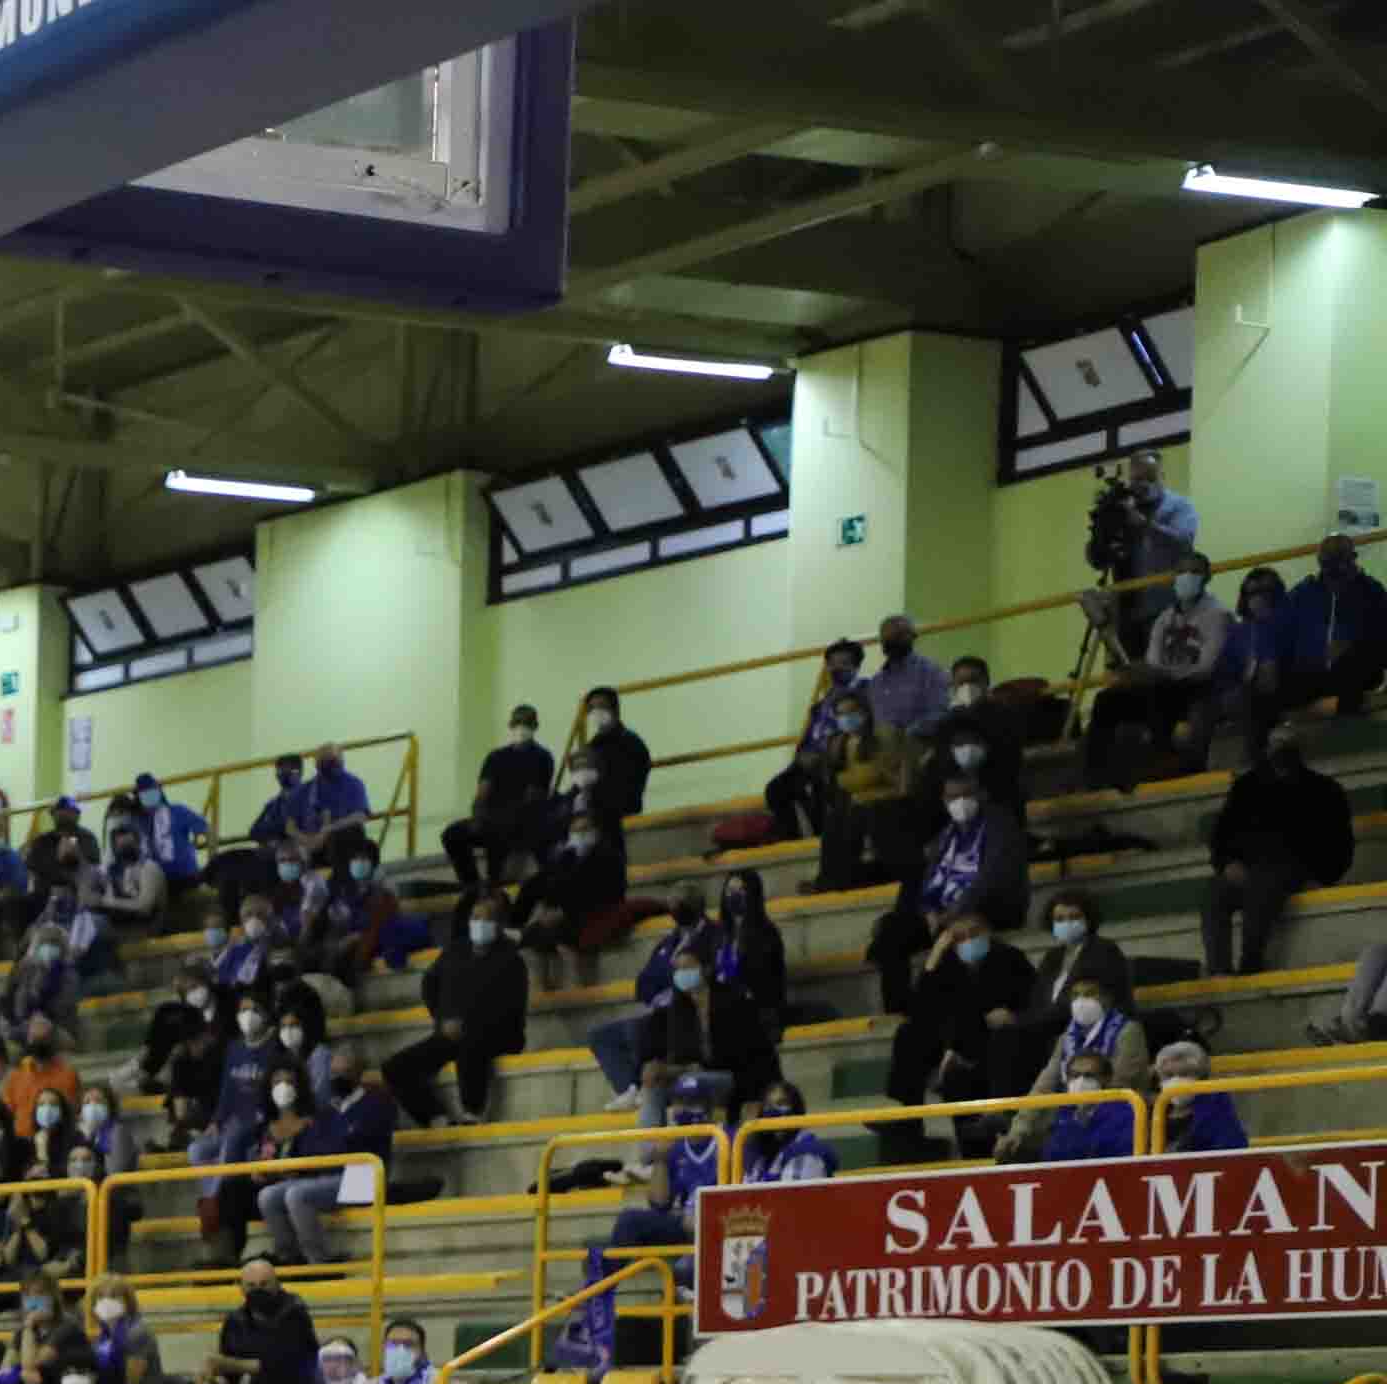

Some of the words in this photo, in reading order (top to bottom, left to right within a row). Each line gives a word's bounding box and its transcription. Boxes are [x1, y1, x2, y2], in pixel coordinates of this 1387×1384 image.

[884, 1160, 1386, 1256] SALAMAN
[794, 1257, 1093, 1322] PATRIMONIO
[1107, 1254, 1183, 1311] DE
[1200, 1251, 1267, 1307] LA
